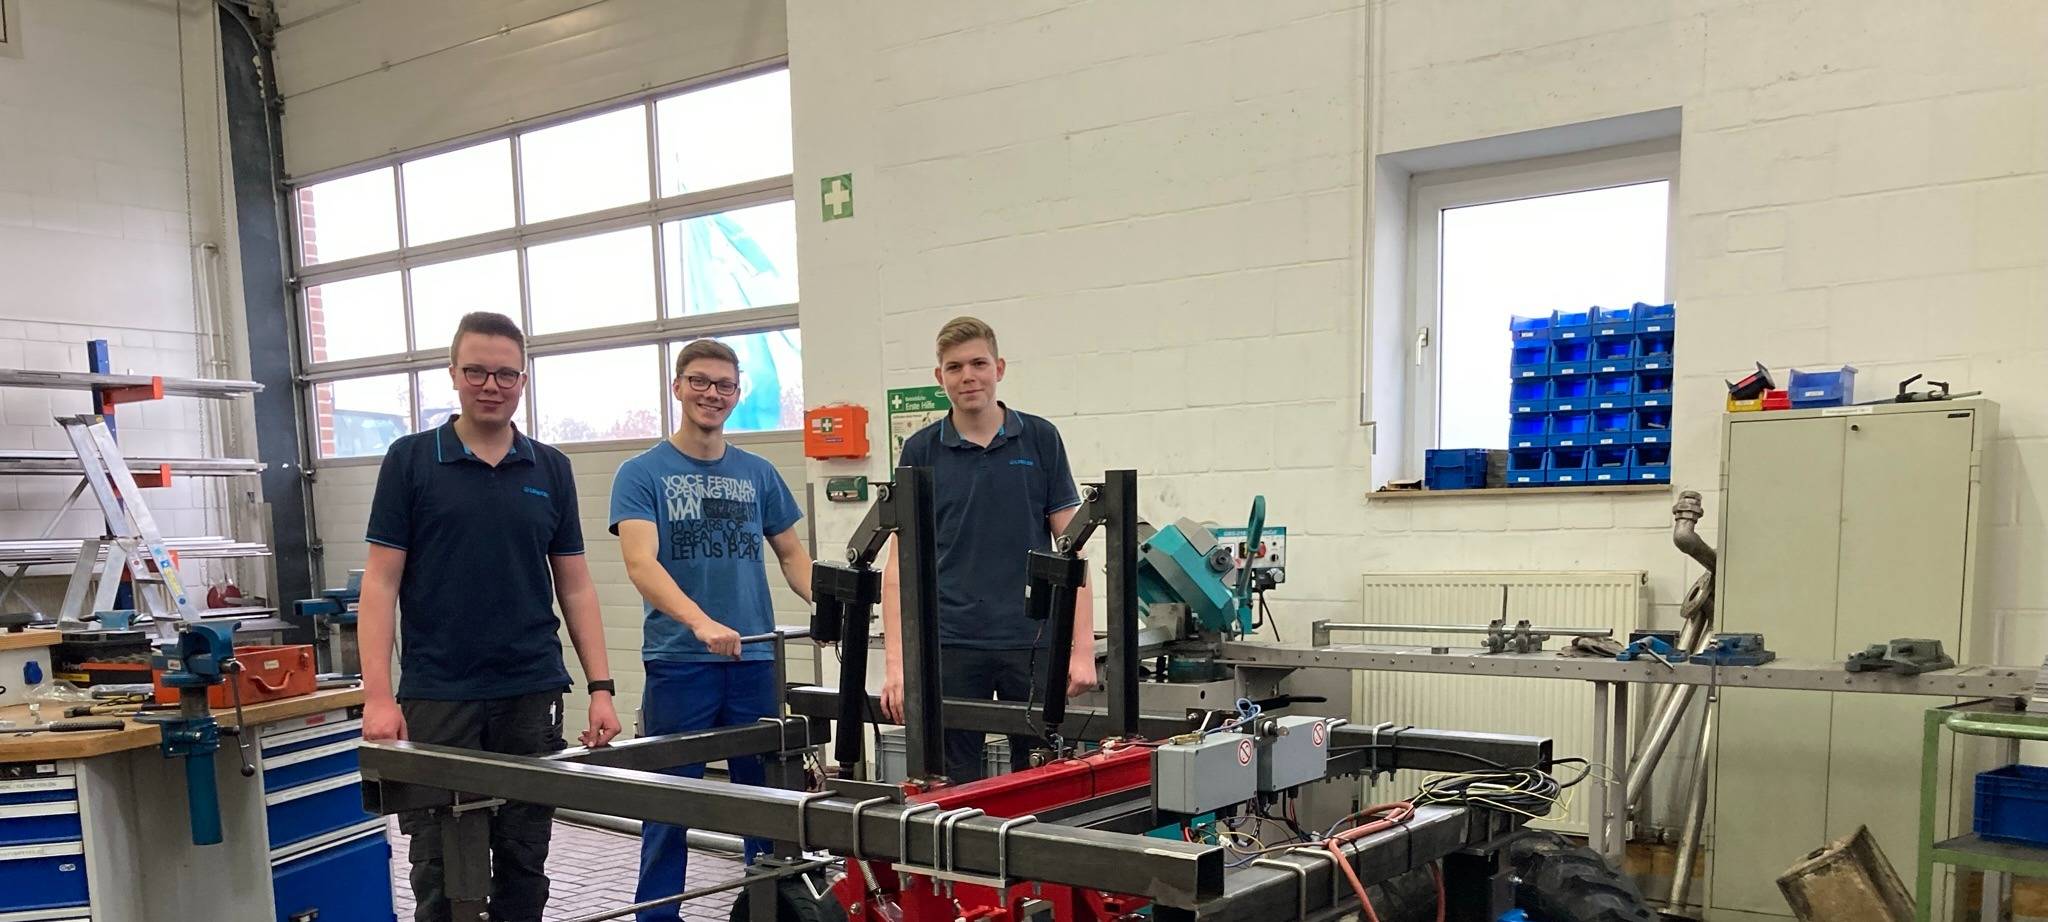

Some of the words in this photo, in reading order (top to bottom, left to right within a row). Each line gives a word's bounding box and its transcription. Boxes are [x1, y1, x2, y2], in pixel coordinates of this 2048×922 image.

[661, 474, 704, 487] VOICE
[707, 475, 753, 490] FESTIVAL
[665, 486, 723, 499] OPENING
[725, 487, 756, 503] PARTY
[667, 498, 701, 521] MAY
[669, 520, 684, 532] 10
[687, 519, 723, 532] YEARS
[727, 519, 744, 531] OF
[671, 530, 713, 545] GREAT
[722, 530, 761, 545] MUSIC
[672, 544, 696, 560] LET
[703, 541, 723, 558] US
[728, 542, 761, 560] PLAY
